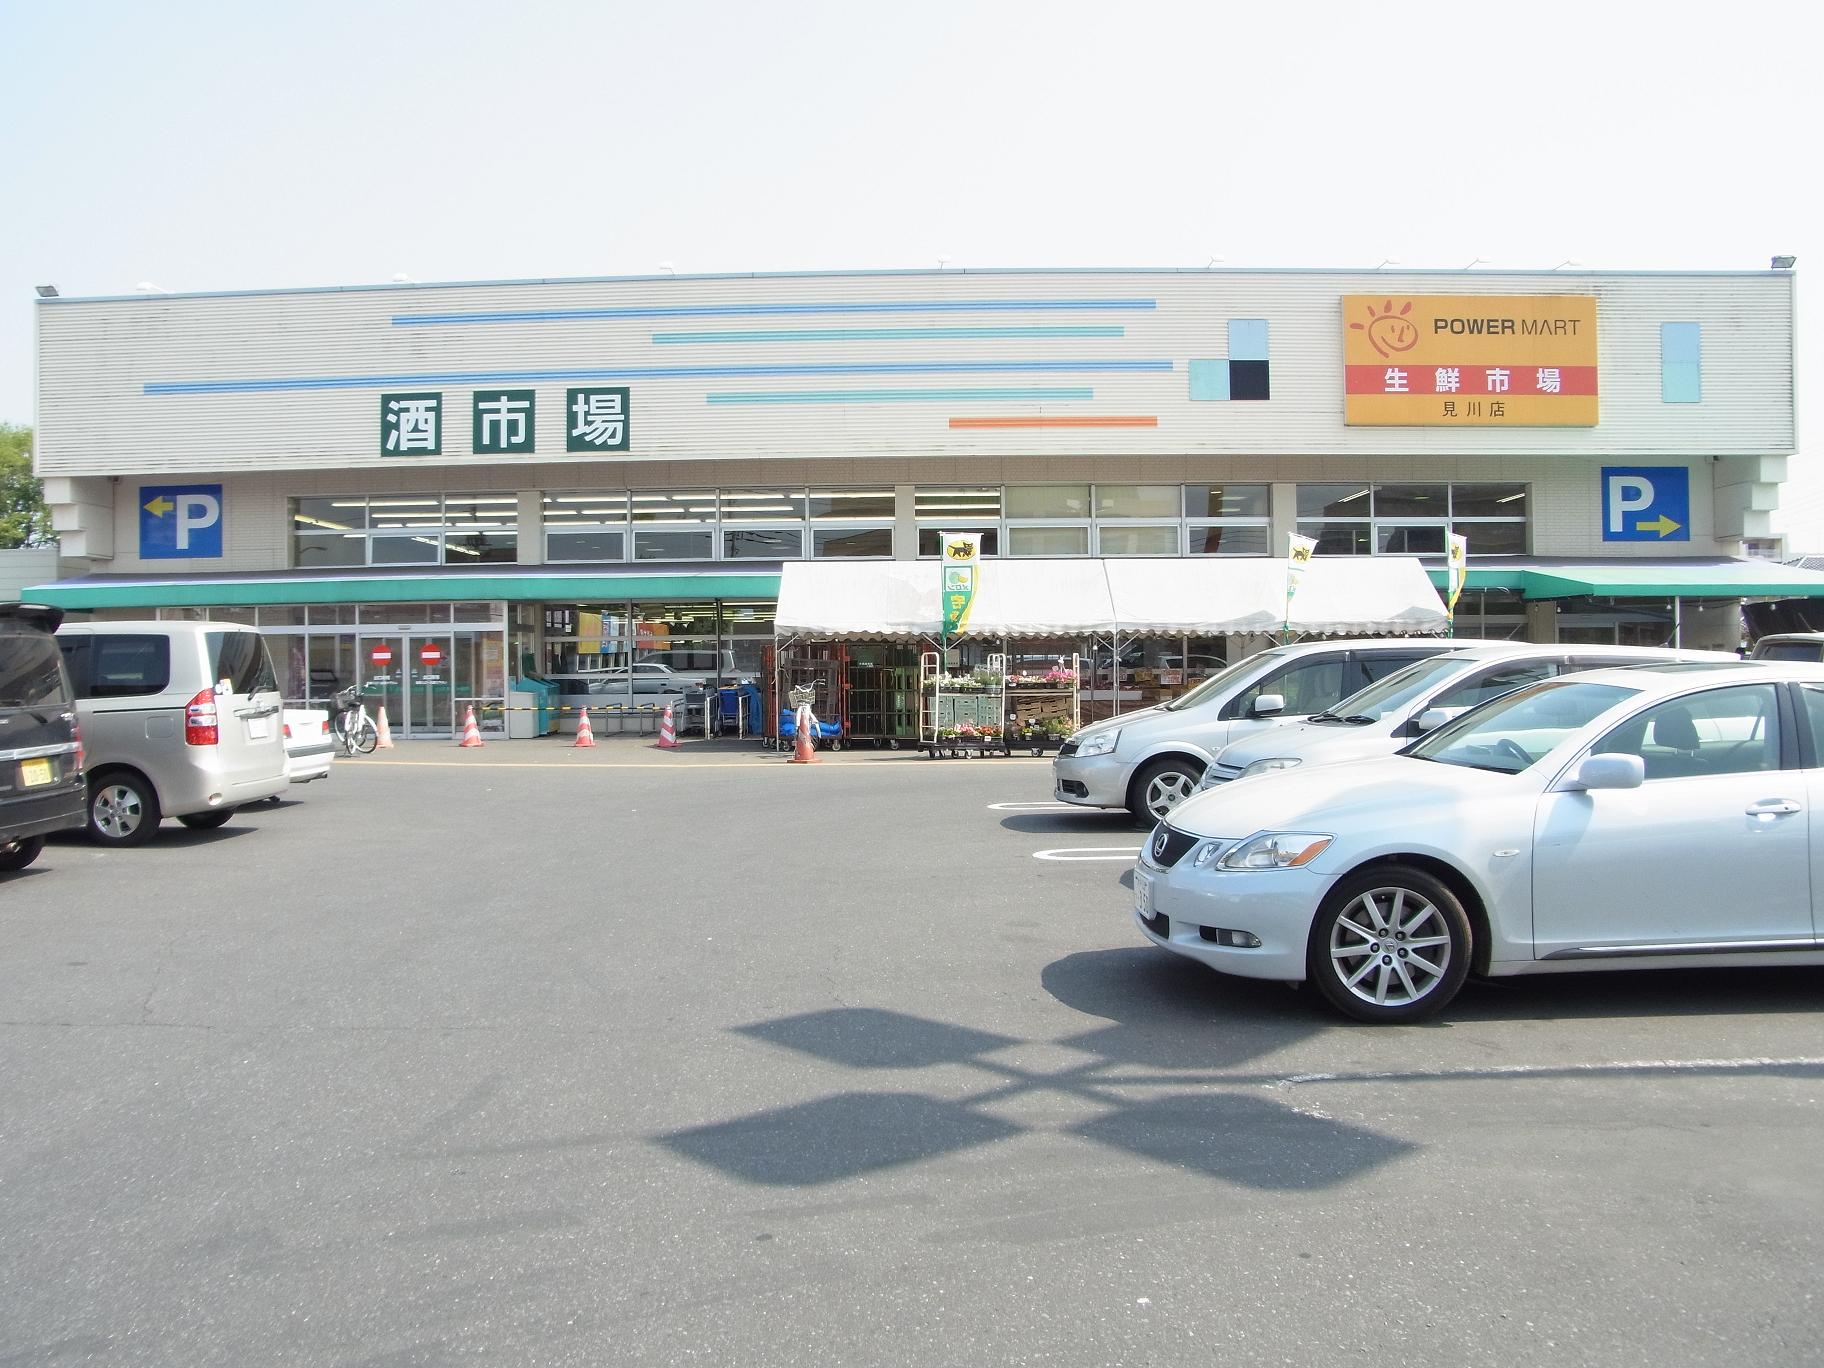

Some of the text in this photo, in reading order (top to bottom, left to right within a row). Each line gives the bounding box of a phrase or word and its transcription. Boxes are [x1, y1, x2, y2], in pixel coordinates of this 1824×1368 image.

[1434, 318, 1581, 335] POWER MART
[1384, 367, 1561, 393] 生鮮市場
[386, 393, 625, 451] 酒市場
[1443, 401, 1505, 417] 見川店
[176, 494, 220, 550] P
[1609, 476, 1655, 533] P
